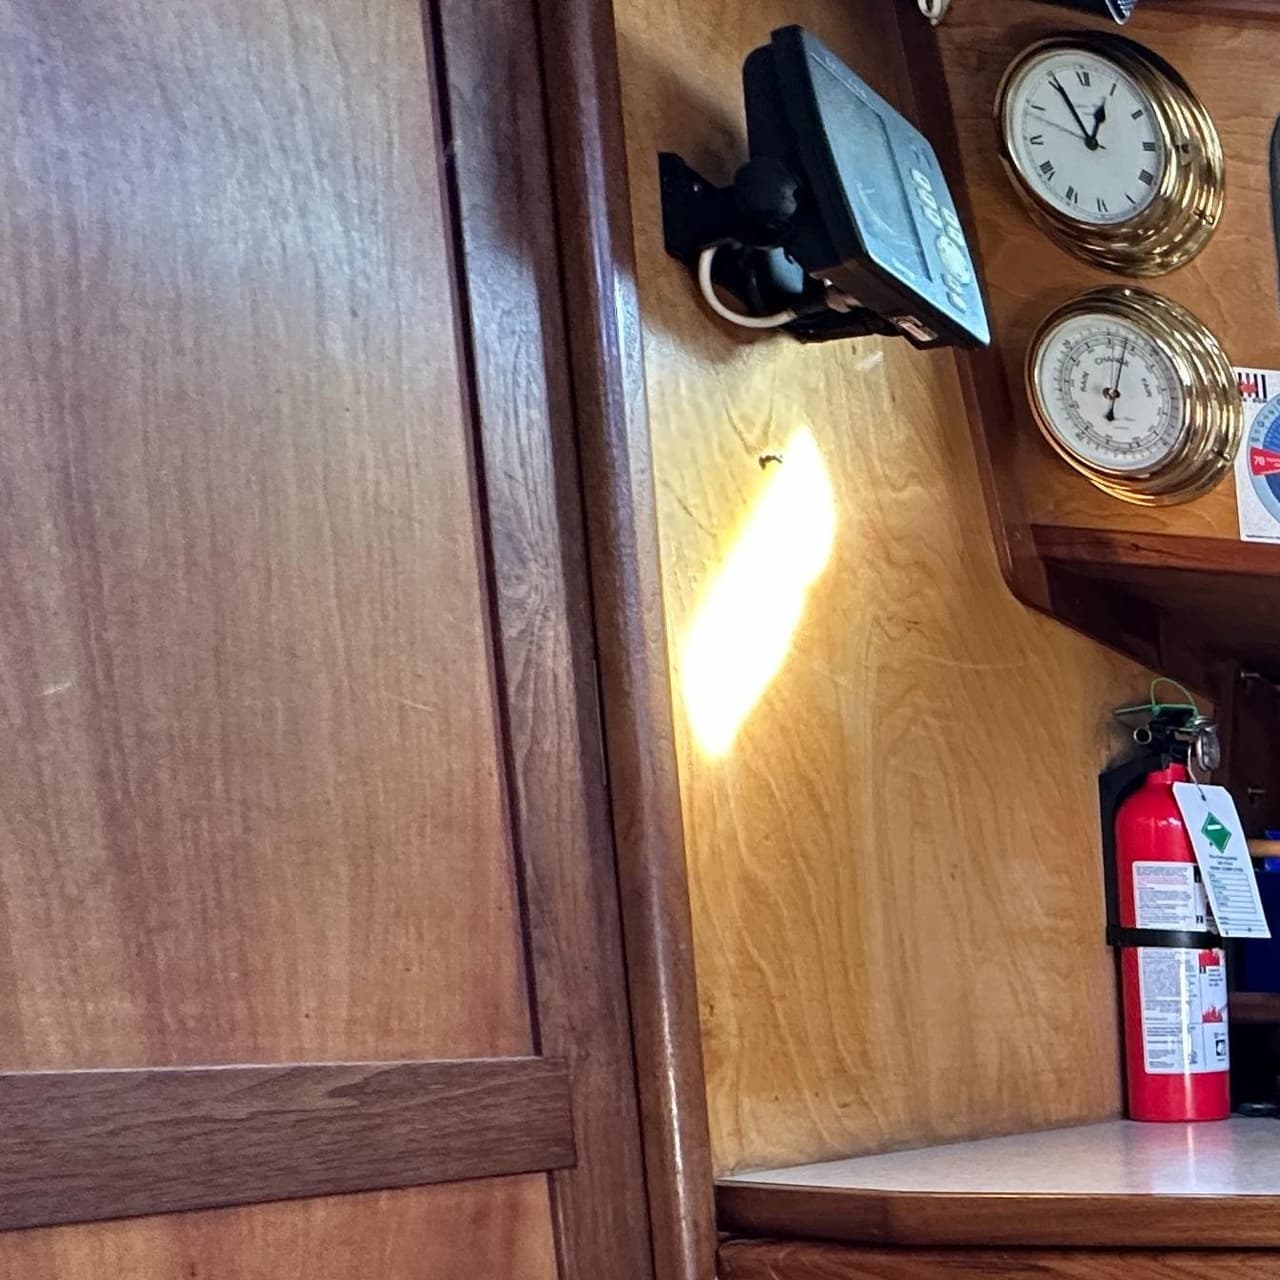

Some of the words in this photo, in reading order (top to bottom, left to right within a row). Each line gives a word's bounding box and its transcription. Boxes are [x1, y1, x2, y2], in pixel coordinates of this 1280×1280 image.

[1094, 355, 1130, 367] CHANGE
[1080, 371, 1090, 392] RAIN
[1141, 377, 1153, 398] FAIR
[1253, 456, 1266, 466] 70
